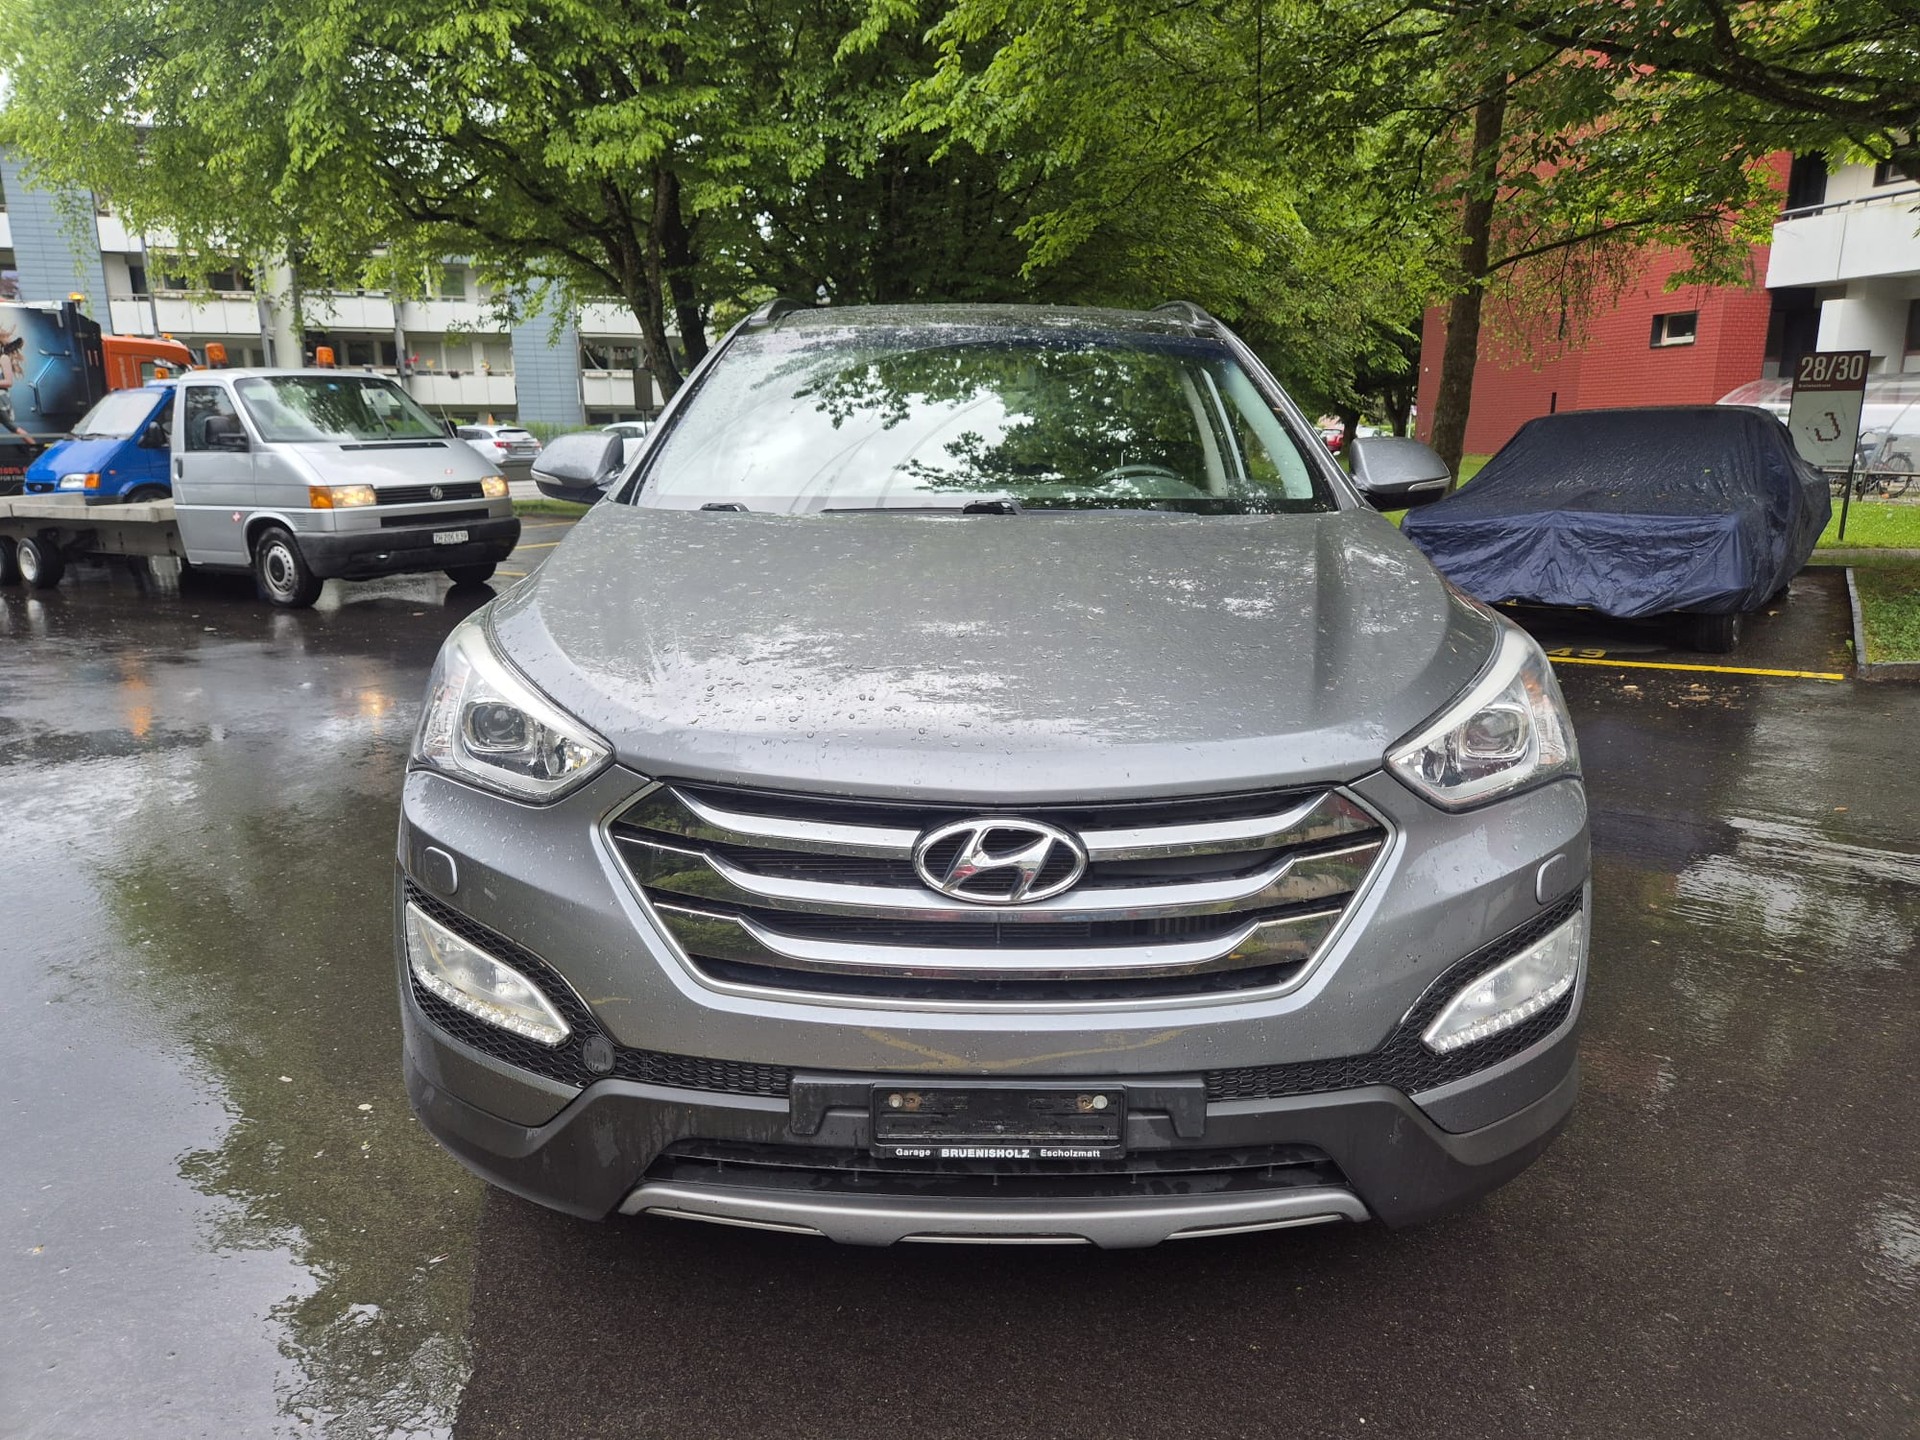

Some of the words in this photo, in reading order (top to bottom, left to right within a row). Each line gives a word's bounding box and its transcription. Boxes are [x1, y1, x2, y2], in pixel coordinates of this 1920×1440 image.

[1800, 355, 1864, 381] 28/30
[895, 1148, 931, 1158] Garage
[941, 1148, 1030, 1159] BRUENISHOLZ
[1040, 1148, 1100, 1158] Escholzmatt
